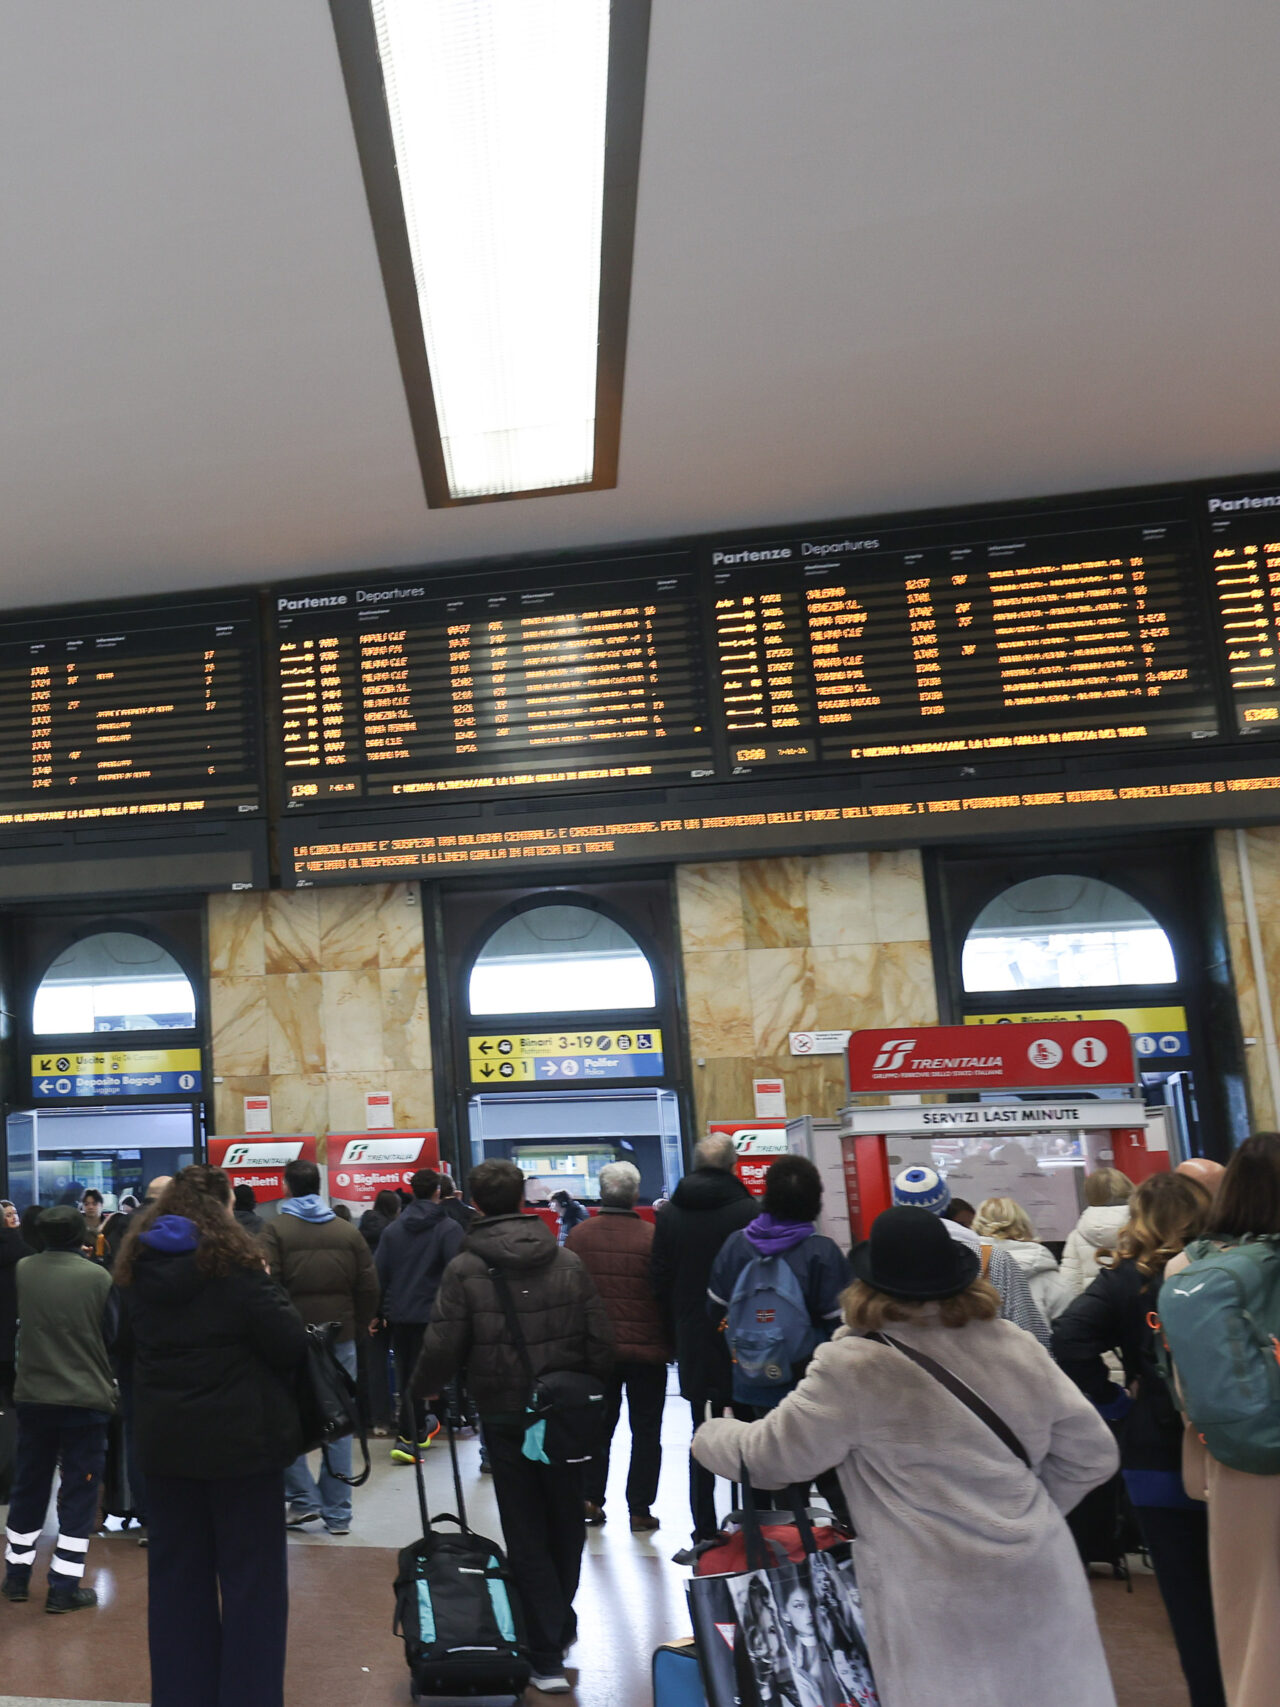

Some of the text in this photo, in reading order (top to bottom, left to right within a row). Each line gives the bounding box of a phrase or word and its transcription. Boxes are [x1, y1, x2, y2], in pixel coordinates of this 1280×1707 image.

[712, 538, 880, 565] Partenze Departures
[278, 586, 425, 611] Partenze Departures
[294, 846, 308, 857] LA
[520, 1036, 593, 1049] Binari 3-19
[76, 1056, 105, 1065] Uscita
[522, 1058, 619, 1073] 1 Polfer
[911, 1056, 1003, 1070] TRENITALIA
[76, 1075, 162, 1088] Deposito Bagagli
[923, 1108, 1080, 1124] SERVIZI LAST MINUTE
[1130, 1134, 1140, 1147] 1
[234, 1176, 279, 1188] Biglietti
[353, 1173, 400, 1185] Biglietti
